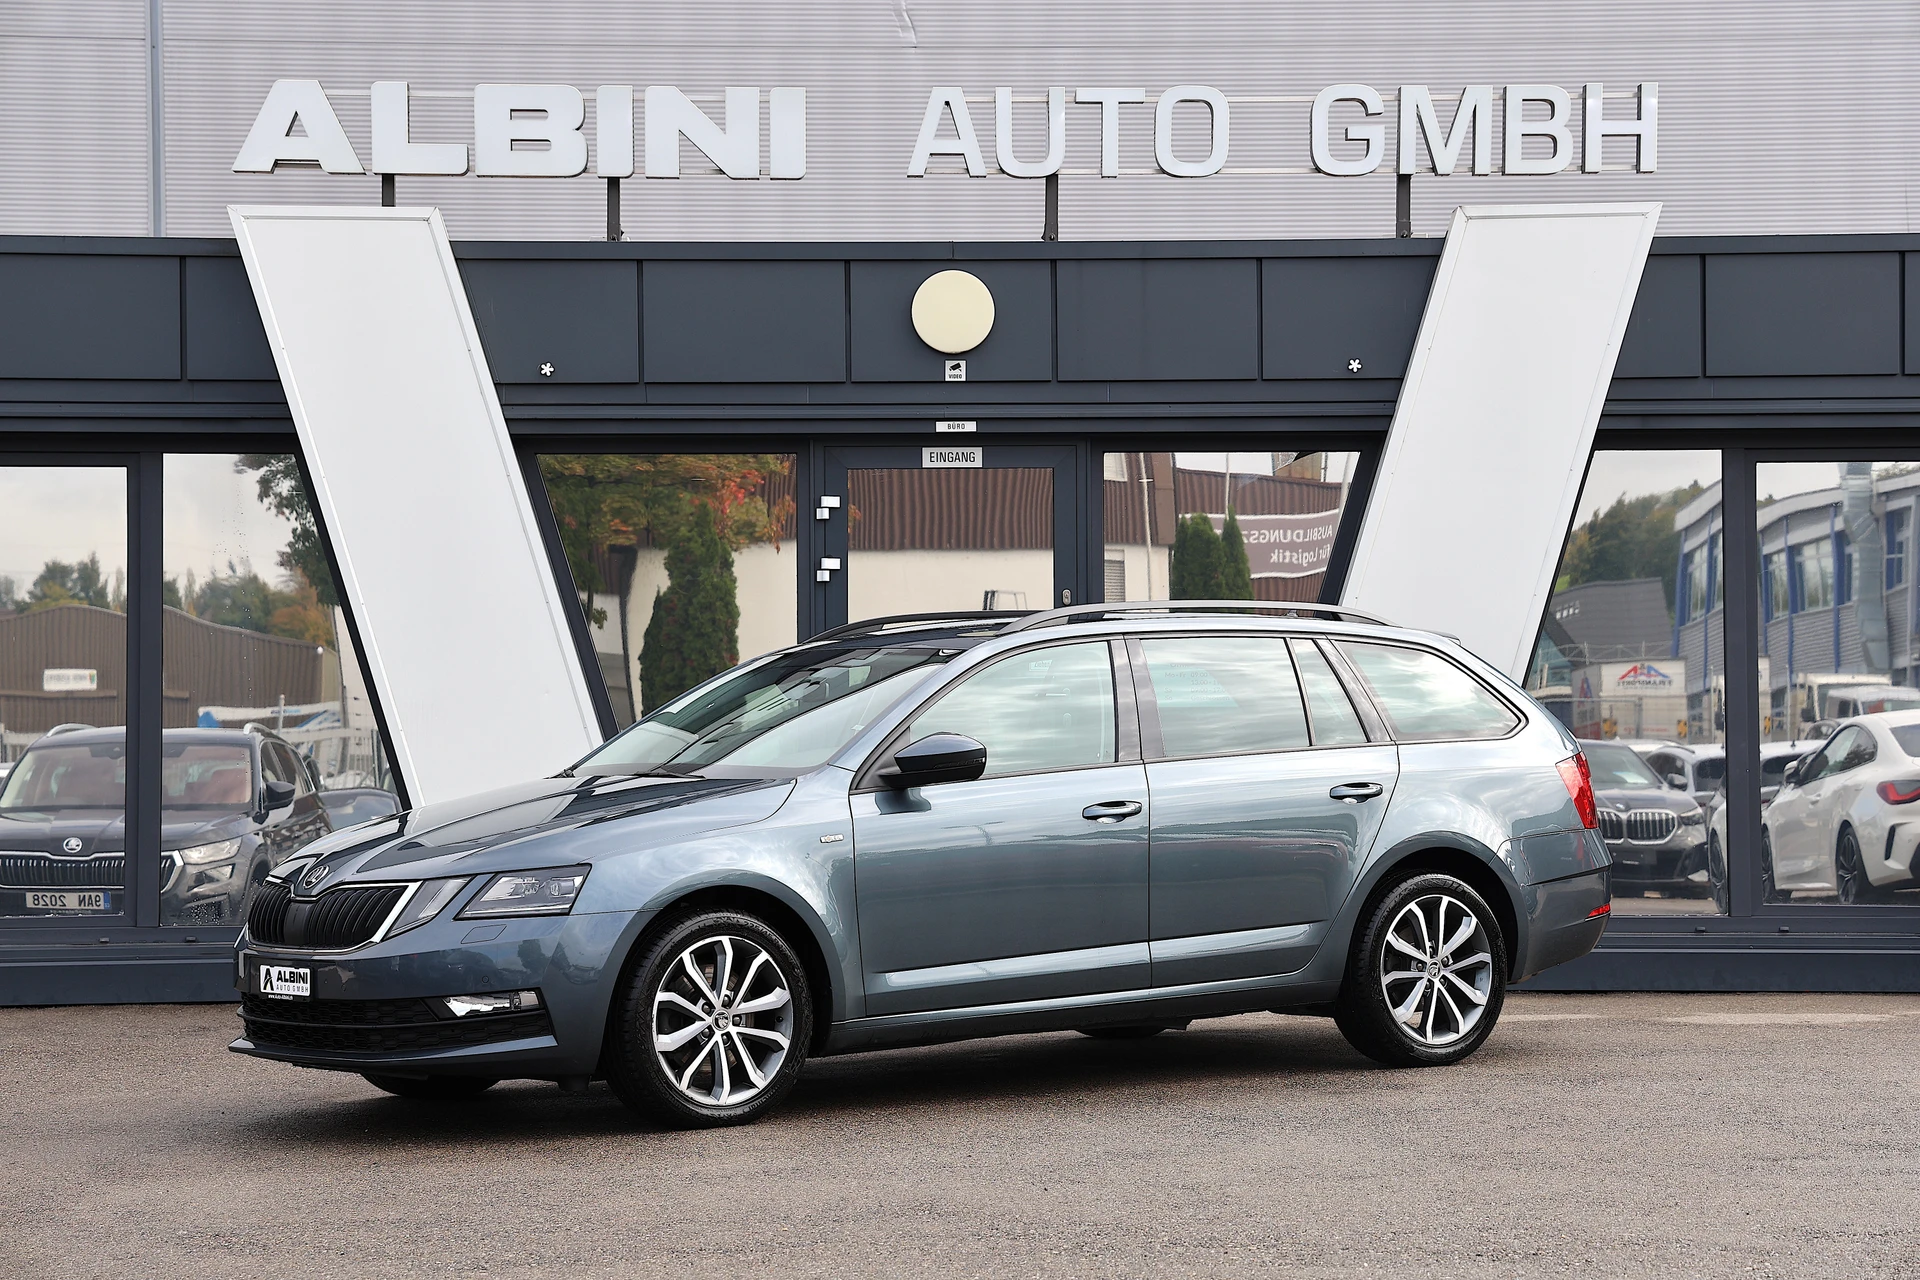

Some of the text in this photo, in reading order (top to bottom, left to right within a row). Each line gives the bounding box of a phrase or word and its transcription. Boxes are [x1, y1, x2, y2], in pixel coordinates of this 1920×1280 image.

[232, 79, 1658, 181] ALBINI AUTO GMBH
[947, 422, 966, 430] BÜRO
[929, 451, 976, 463] EINGANG
[276, 970, 308, 984] ALBINI
